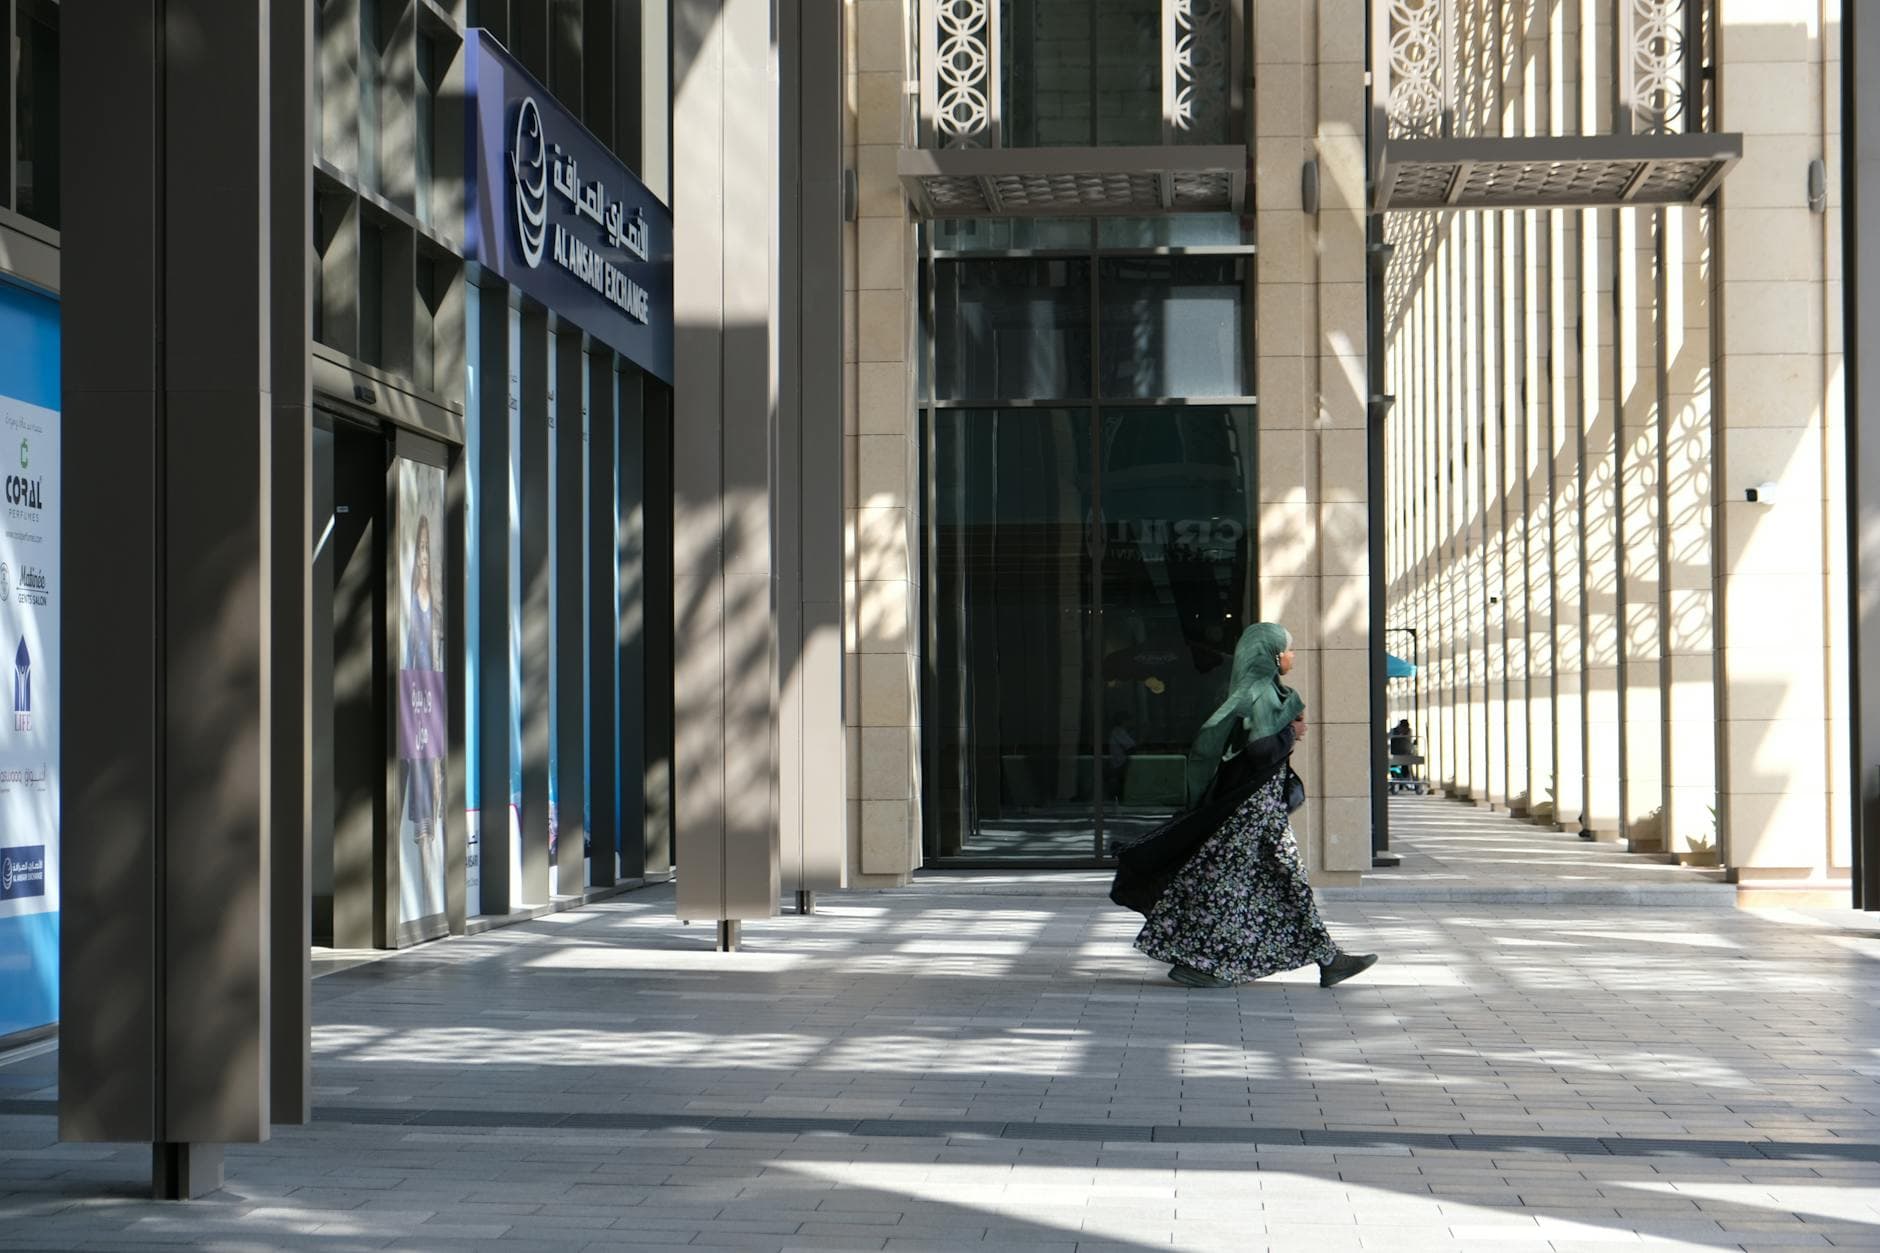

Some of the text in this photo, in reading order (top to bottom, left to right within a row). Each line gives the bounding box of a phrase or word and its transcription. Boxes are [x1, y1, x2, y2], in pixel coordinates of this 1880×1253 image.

[606, 201, 649, 262] الأنصاري
[554, 223, 649, 326] AL ANSARI EXCHANGE
[6, 475, 42, 510] CORAL
[9, 508, 40, 522] PERFUMES
[15, 714, 32, 731] LIFE
